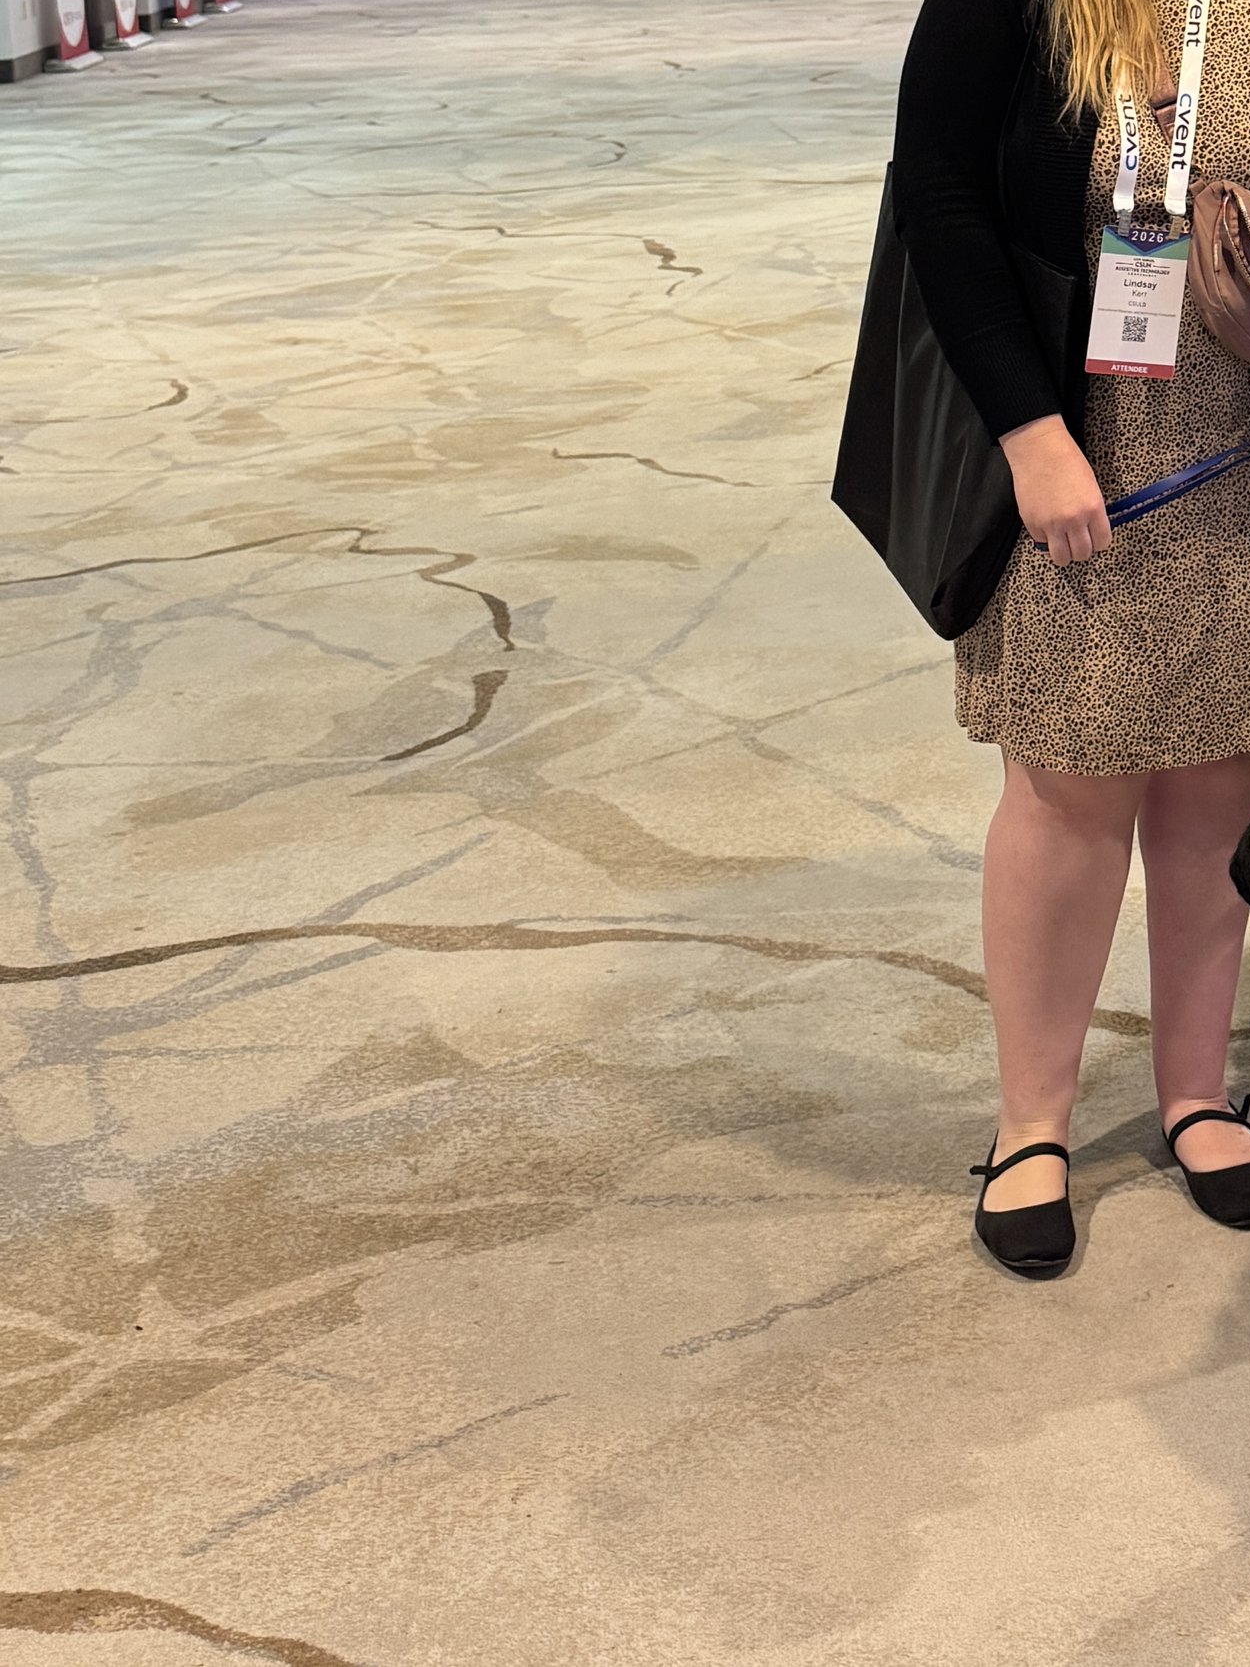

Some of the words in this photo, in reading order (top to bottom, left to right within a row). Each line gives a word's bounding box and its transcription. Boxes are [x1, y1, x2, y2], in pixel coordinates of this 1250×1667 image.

[1118, 94, 1138, 171] cvent
[1171, 93, 1193, 170] cvent
[1131, 230, 1164, 243] 2026
[1123, 278, 1158, 291] Lindsay
[1111, 364, 1149, 374] ATTENDEE
